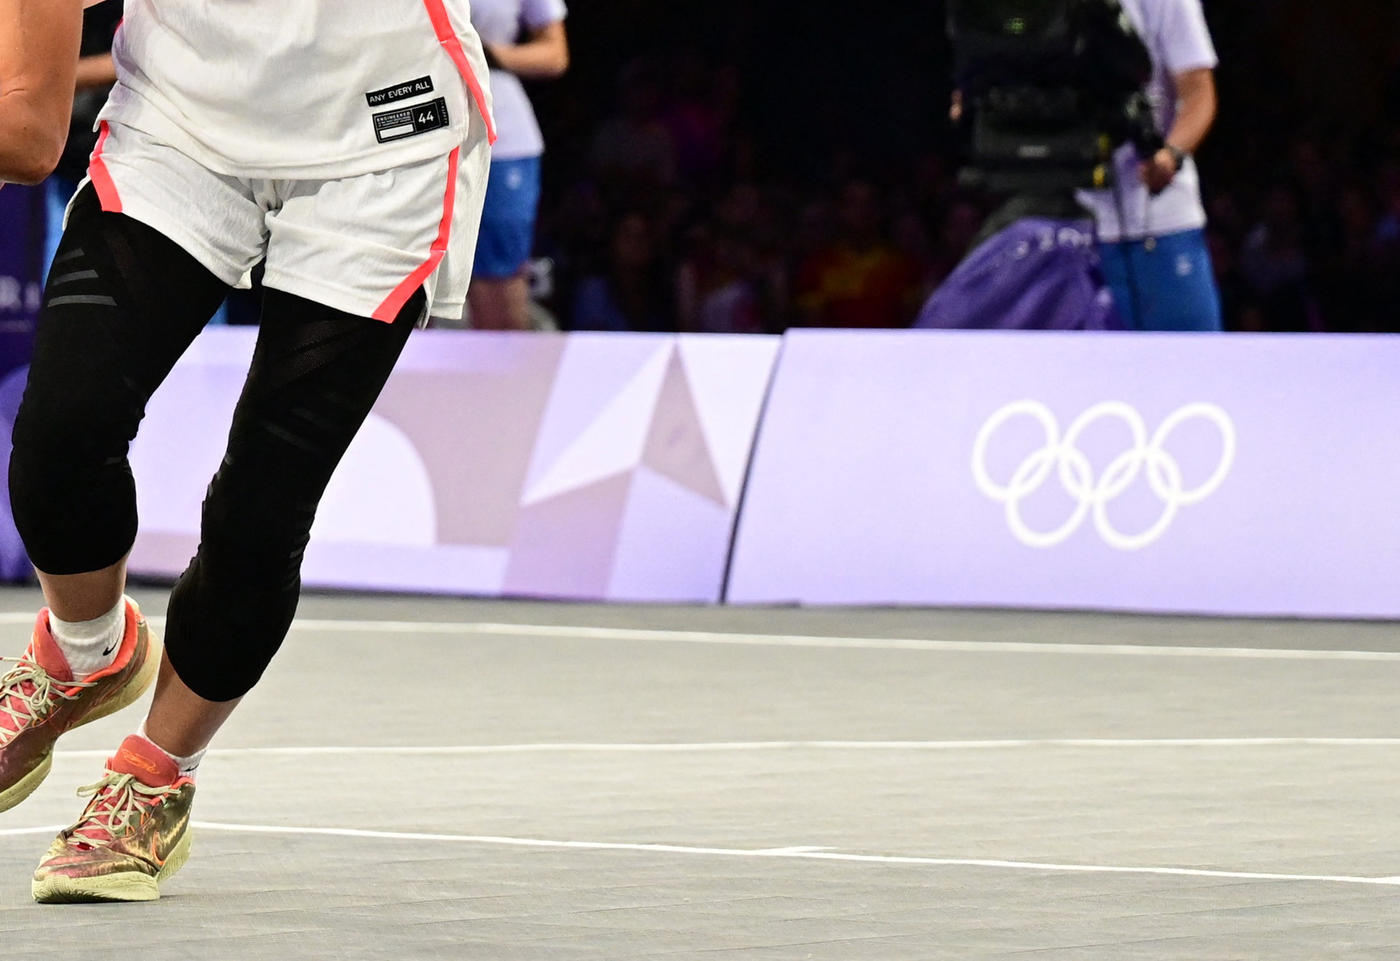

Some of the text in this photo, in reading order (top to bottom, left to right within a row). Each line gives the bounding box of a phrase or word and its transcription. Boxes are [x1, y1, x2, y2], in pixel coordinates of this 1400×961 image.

[369, 81, 430, 103] ANY EVERY ALL
[419, 111, 434, 123] 44
